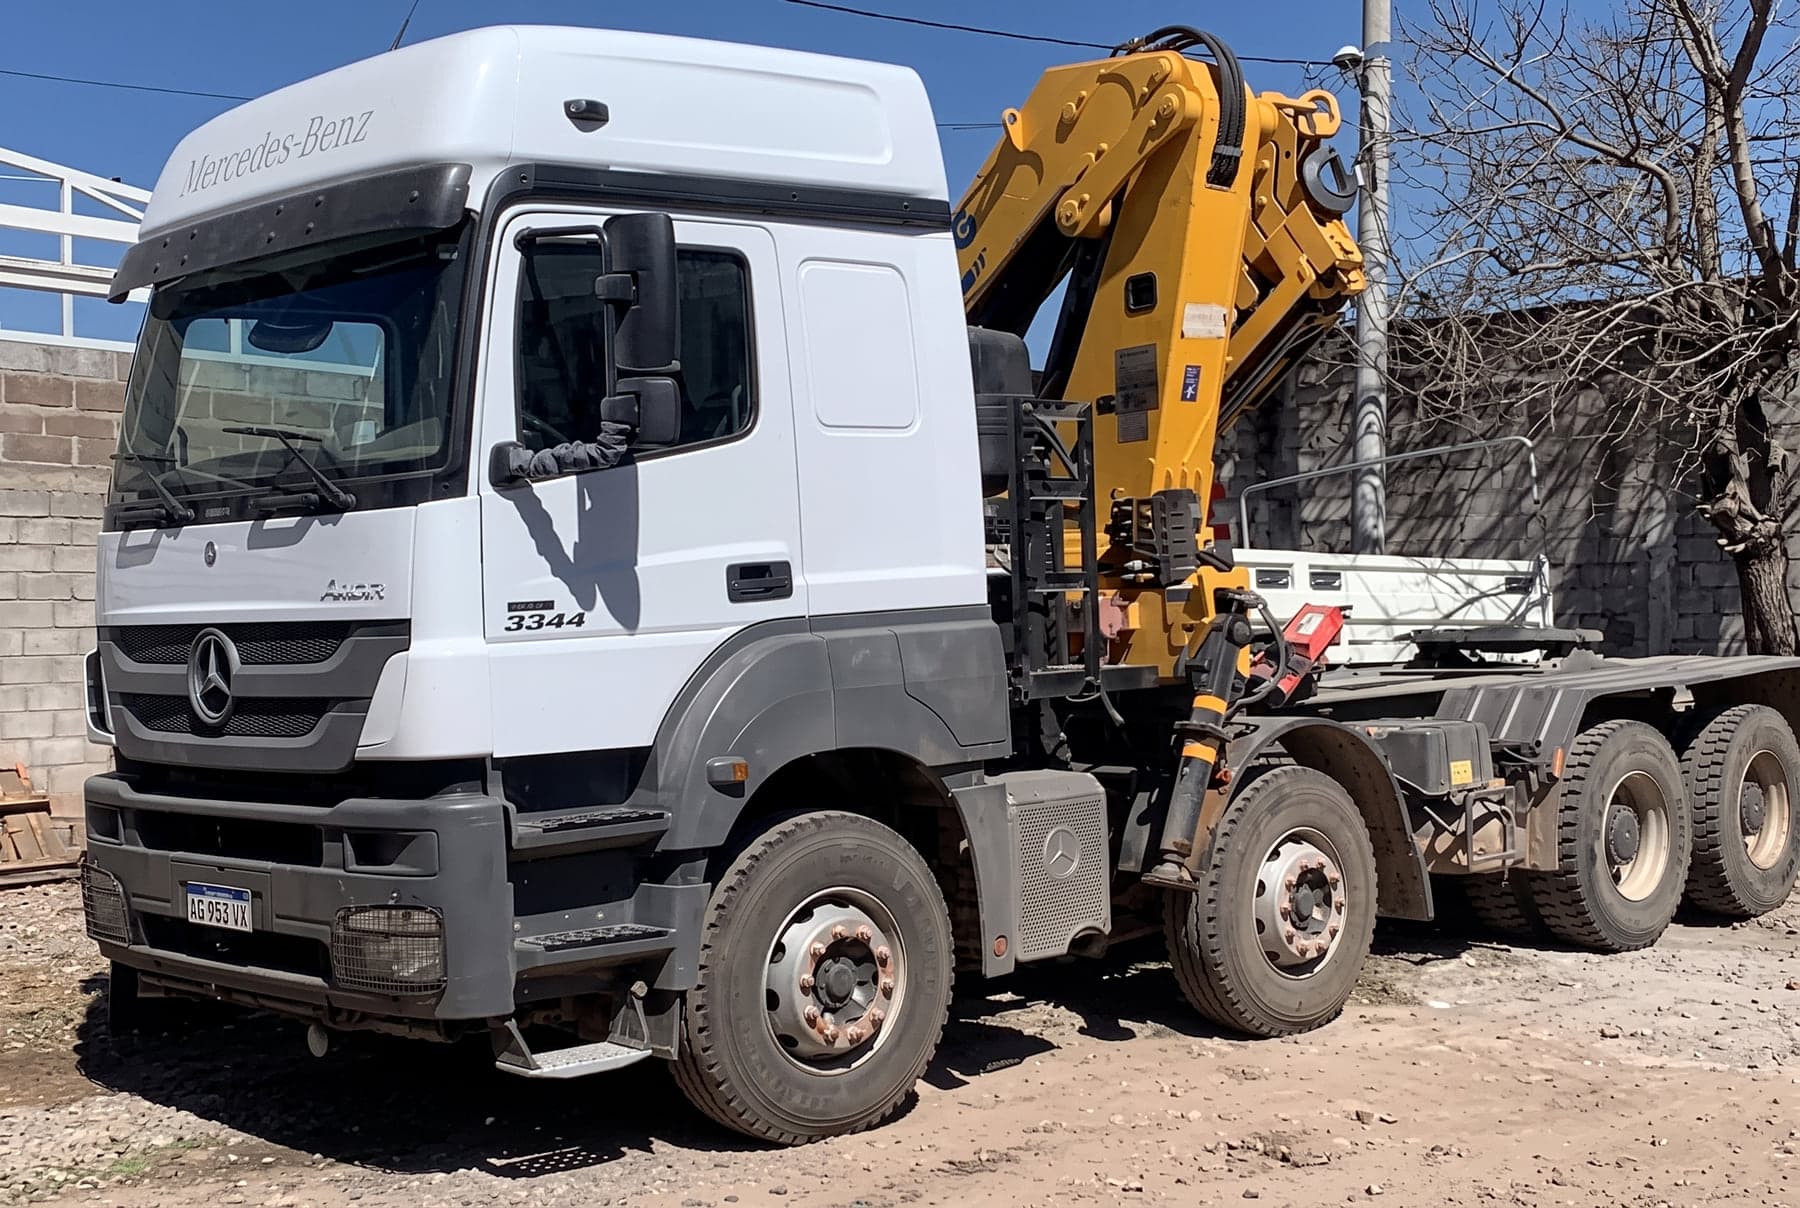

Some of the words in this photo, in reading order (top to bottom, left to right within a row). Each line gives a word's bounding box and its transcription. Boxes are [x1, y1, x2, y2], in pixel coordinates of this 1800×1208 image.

[179, 110, 374, 198] Mercedes-Benz
[504, 612, 586, 632] 3344
[190, 898, 205, 920] AG
[207, 900, 229, 924] 953
[232, 903, 248, 928] VX
